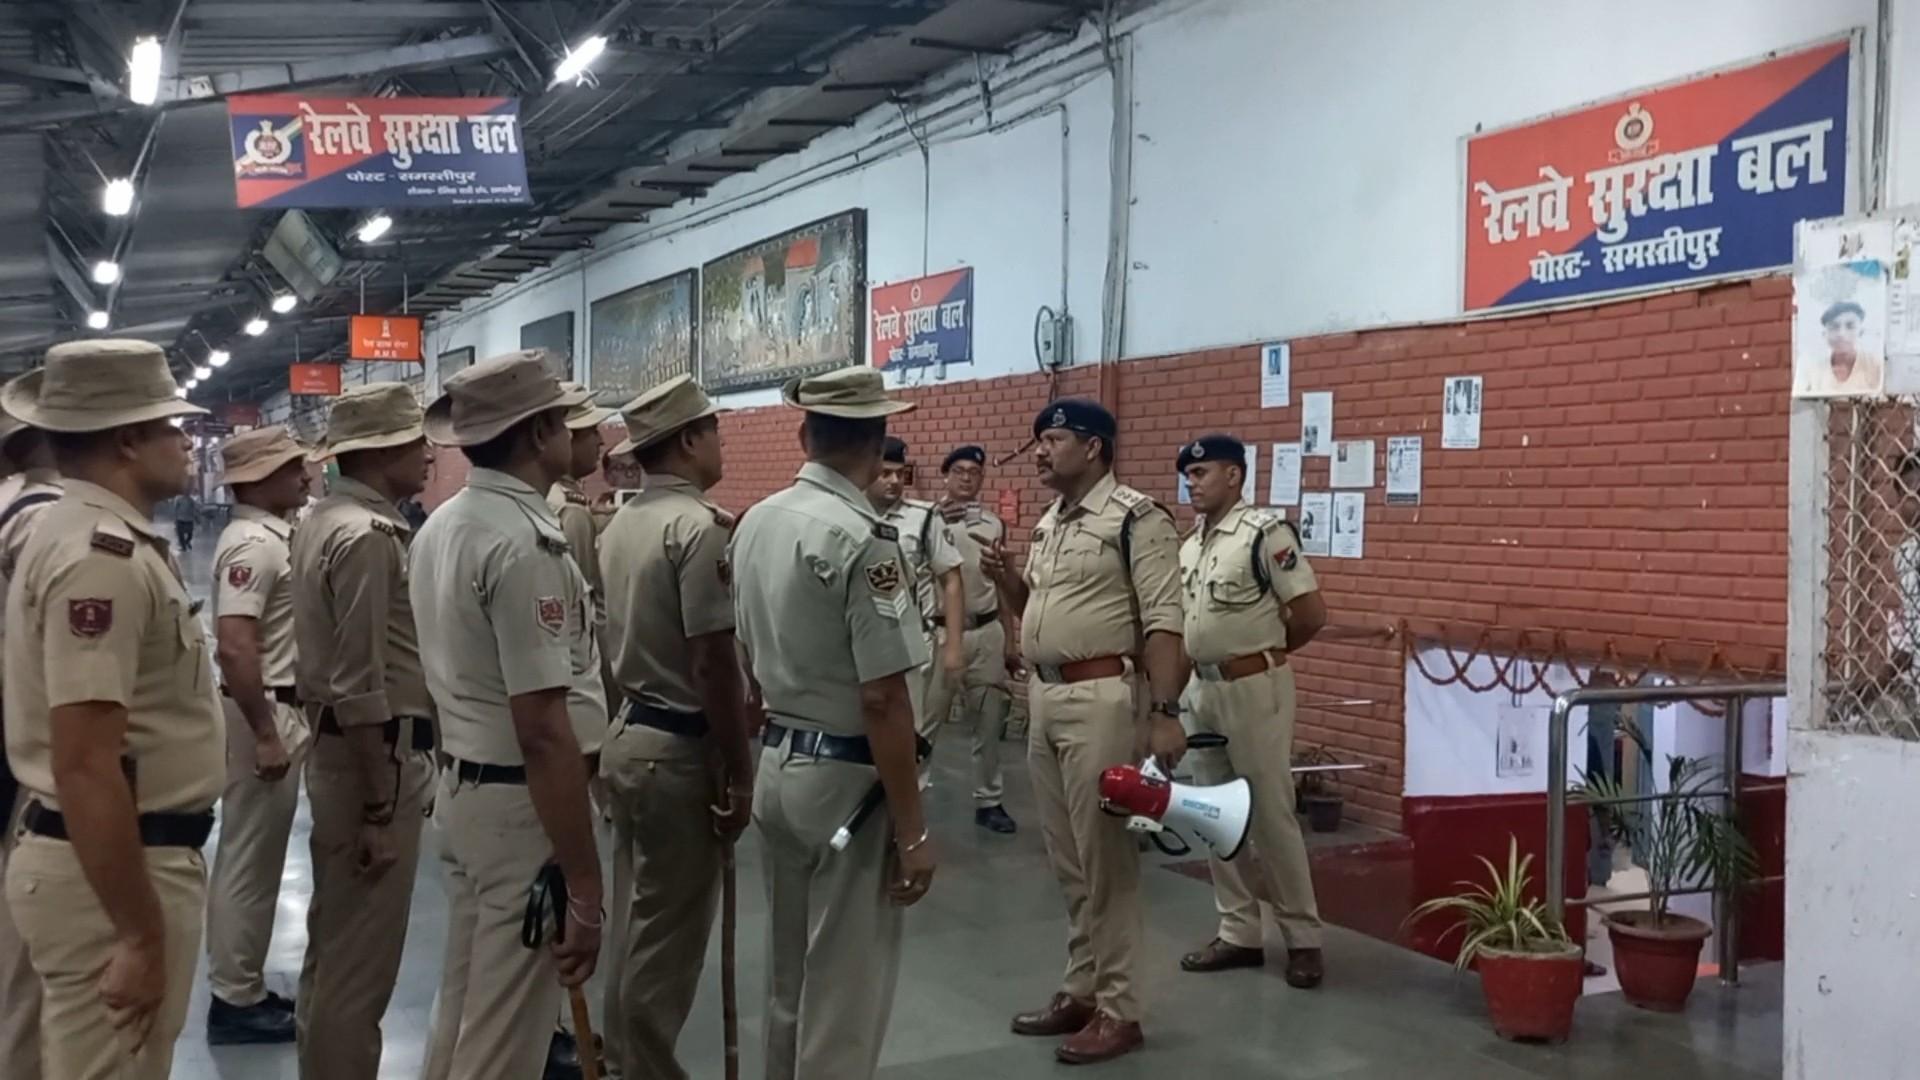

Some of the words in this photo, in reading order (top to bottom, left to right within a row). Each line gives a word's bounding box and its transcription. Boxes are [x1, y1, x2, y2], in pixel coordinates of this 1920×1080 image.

[299, 102, 372, 155] रेलवे
[379, 113, 461, 169] सुरक्षा
[466, 114, 518, 154] बल
[399, 169, 477, 184] समस्तीपुर
[1475, 166, 1574, 244] रेलवे
[1585, 143, 1719, 243] सुरक्षा
[1732, 118, 1833, 194] बल
[1601, 227, 1723, 270] समस्तीपुर
[873, 306, 901, 341] रेलवे
[903, 305, 938, 345] सुरक्षा
